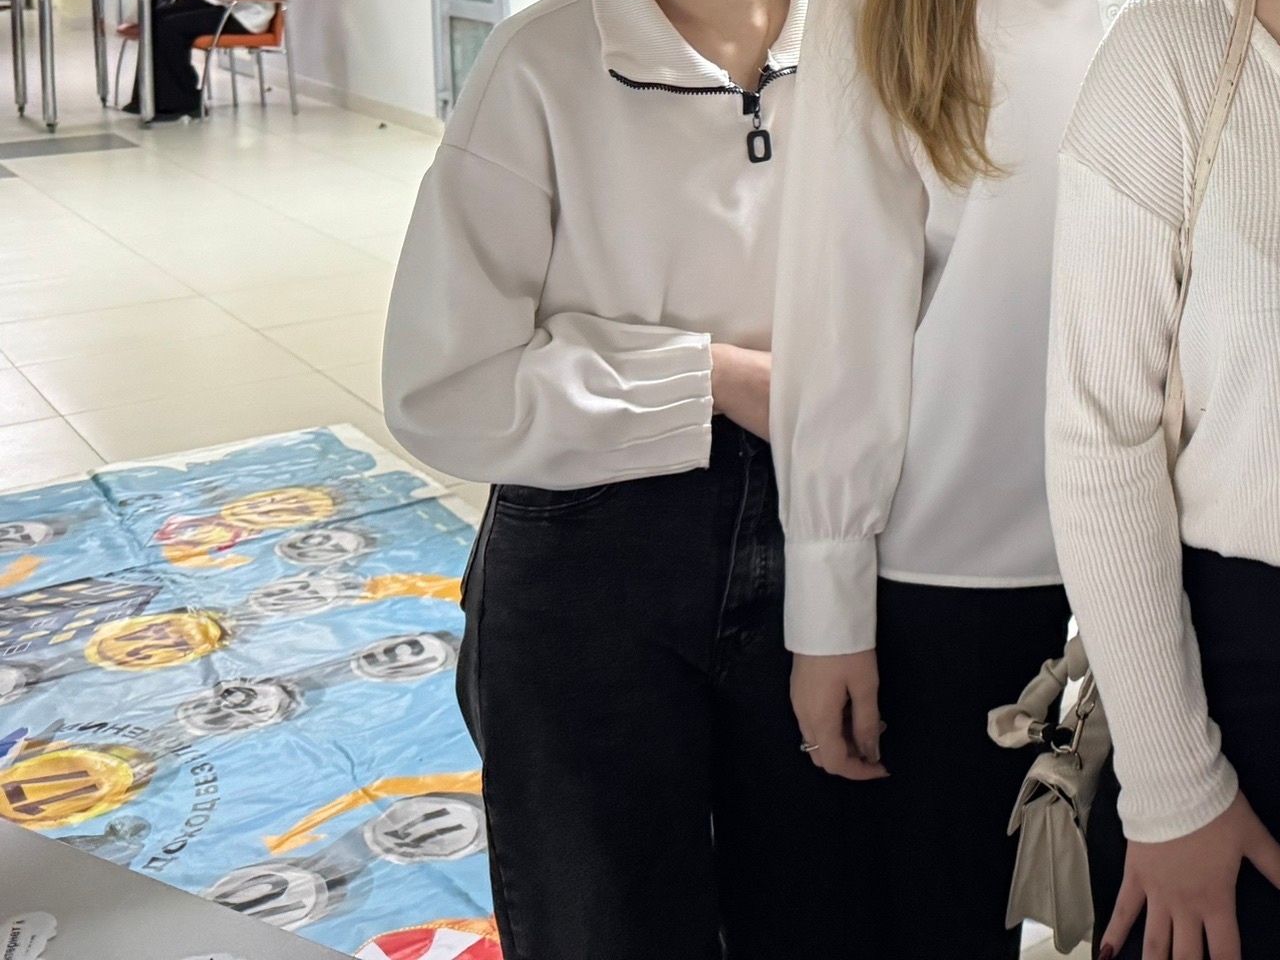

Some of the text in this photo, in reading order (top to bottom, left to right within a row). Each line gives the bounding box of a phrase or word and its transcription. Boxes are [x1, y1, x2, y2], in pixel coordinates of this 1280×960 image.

[361, 639, 439, 674] 15
[1, 770, 100, 816] 17
[142, 797, 221, 872] ДОХОД
[190, 762, 219, 797] БЕЗ
[383, 807, 467, 848] 11
